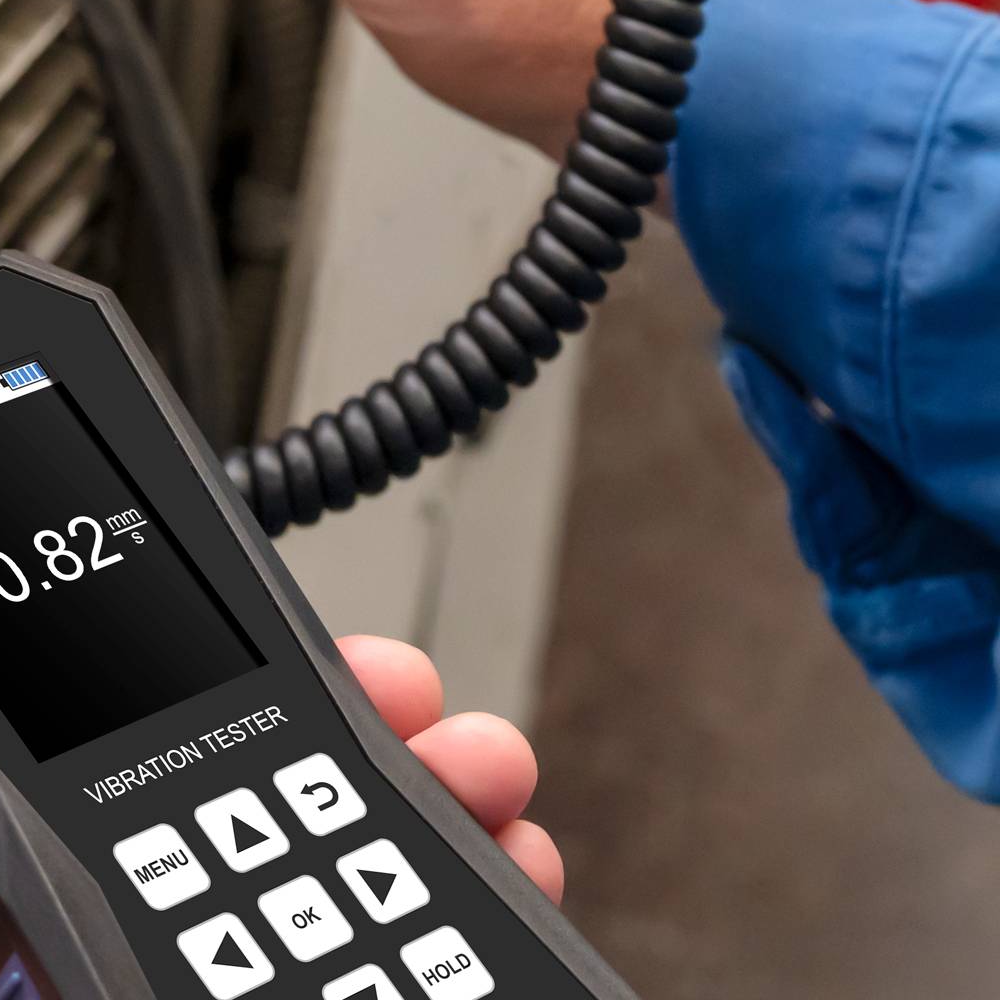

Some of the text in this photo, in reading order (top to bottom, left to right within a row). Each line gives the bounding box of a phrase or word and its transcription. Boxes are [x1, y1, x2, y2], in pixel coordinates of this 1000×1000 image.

[106, 509, 142, 530] mm
[131, 532, 145, 544] s
[83, 704, 288, 805] VIBRATION TESTER
[133, 848, 190, 885] MENU
[291, 907, 322, 930] OK
[421, 953, 472, 986] HOLD
